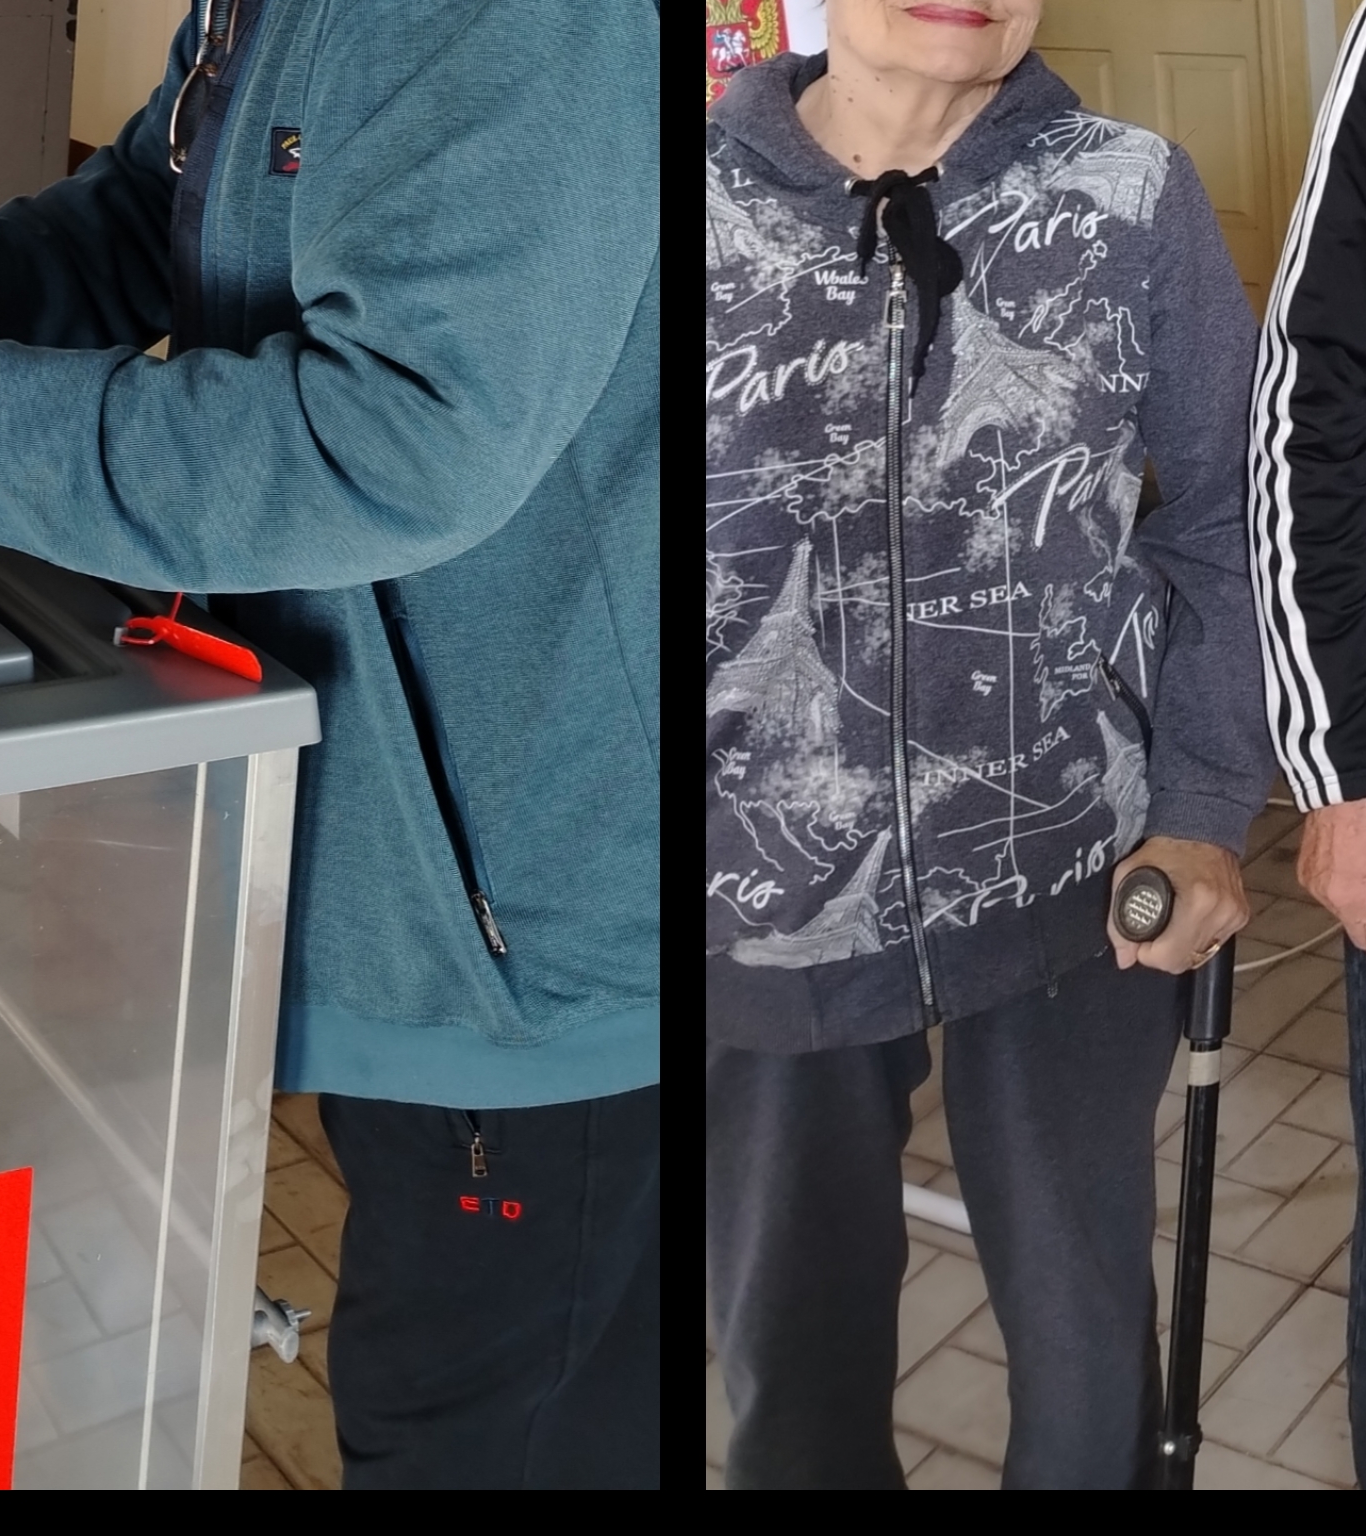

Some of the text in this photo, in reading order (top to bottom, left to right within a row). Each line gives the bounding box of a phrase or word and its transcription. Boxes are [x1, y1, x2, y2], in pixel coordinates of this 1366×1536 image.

[826, 286, 856, 305] Bay
[706, 339, 865, 415] Paris
[970, 581, 1032, 609] SEA
[923, 726, 1071, 786] INNER SEA
